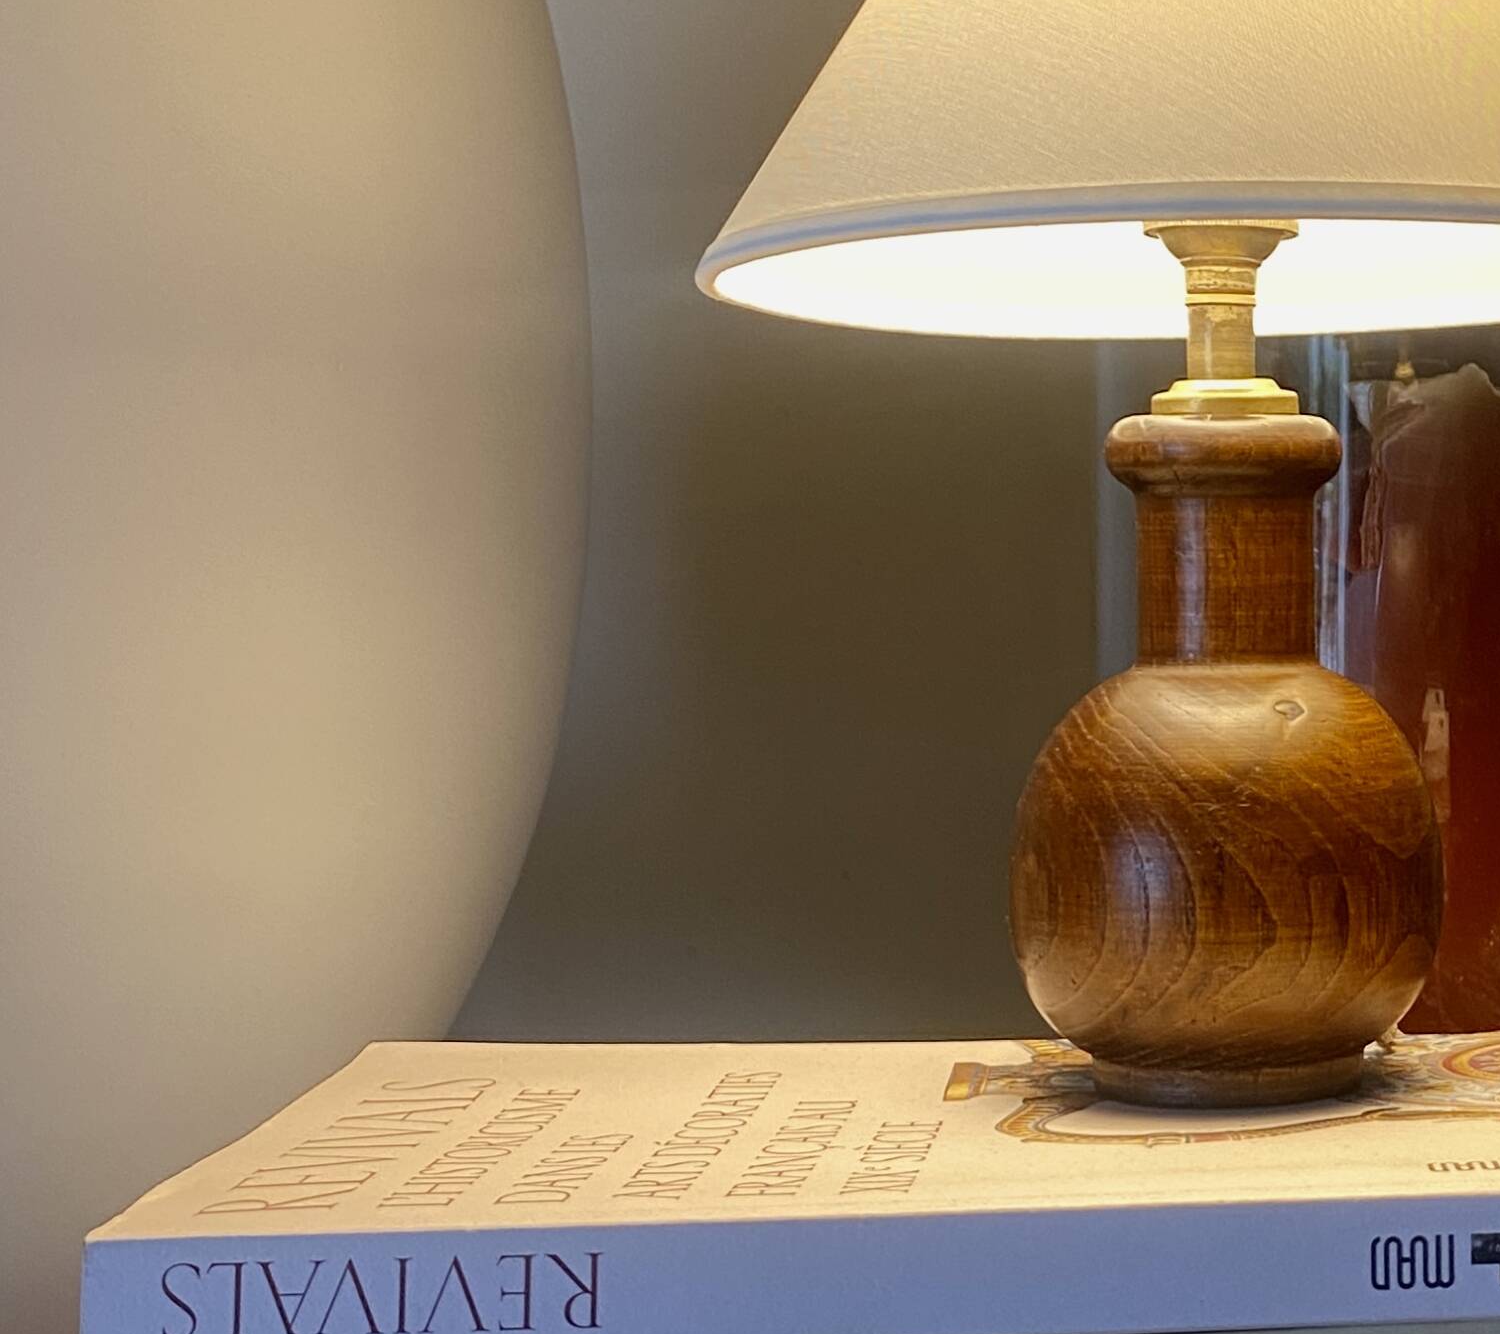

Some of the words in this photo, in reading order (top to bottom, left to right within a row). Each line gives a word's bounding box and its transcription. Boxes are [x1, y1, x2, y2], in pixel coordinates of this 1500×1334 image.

[193, 1077, 498, 1215] REVIVALS
[376, 1087, 582, 1209] L'HISTORICISME
[650, 1070, 783, 1158] DÉCORATIFS
[723, 1123, 844, 1198] FRANÇAIS
[788, 1099, 859, 1122] AU
[853, 1119, 944, 1163] SIÈCLE
[493, 1155, 609, 1205] DANS
[551, 1133, 635, 1154] LES
[611, 1159, 711, 1200] ARTS
